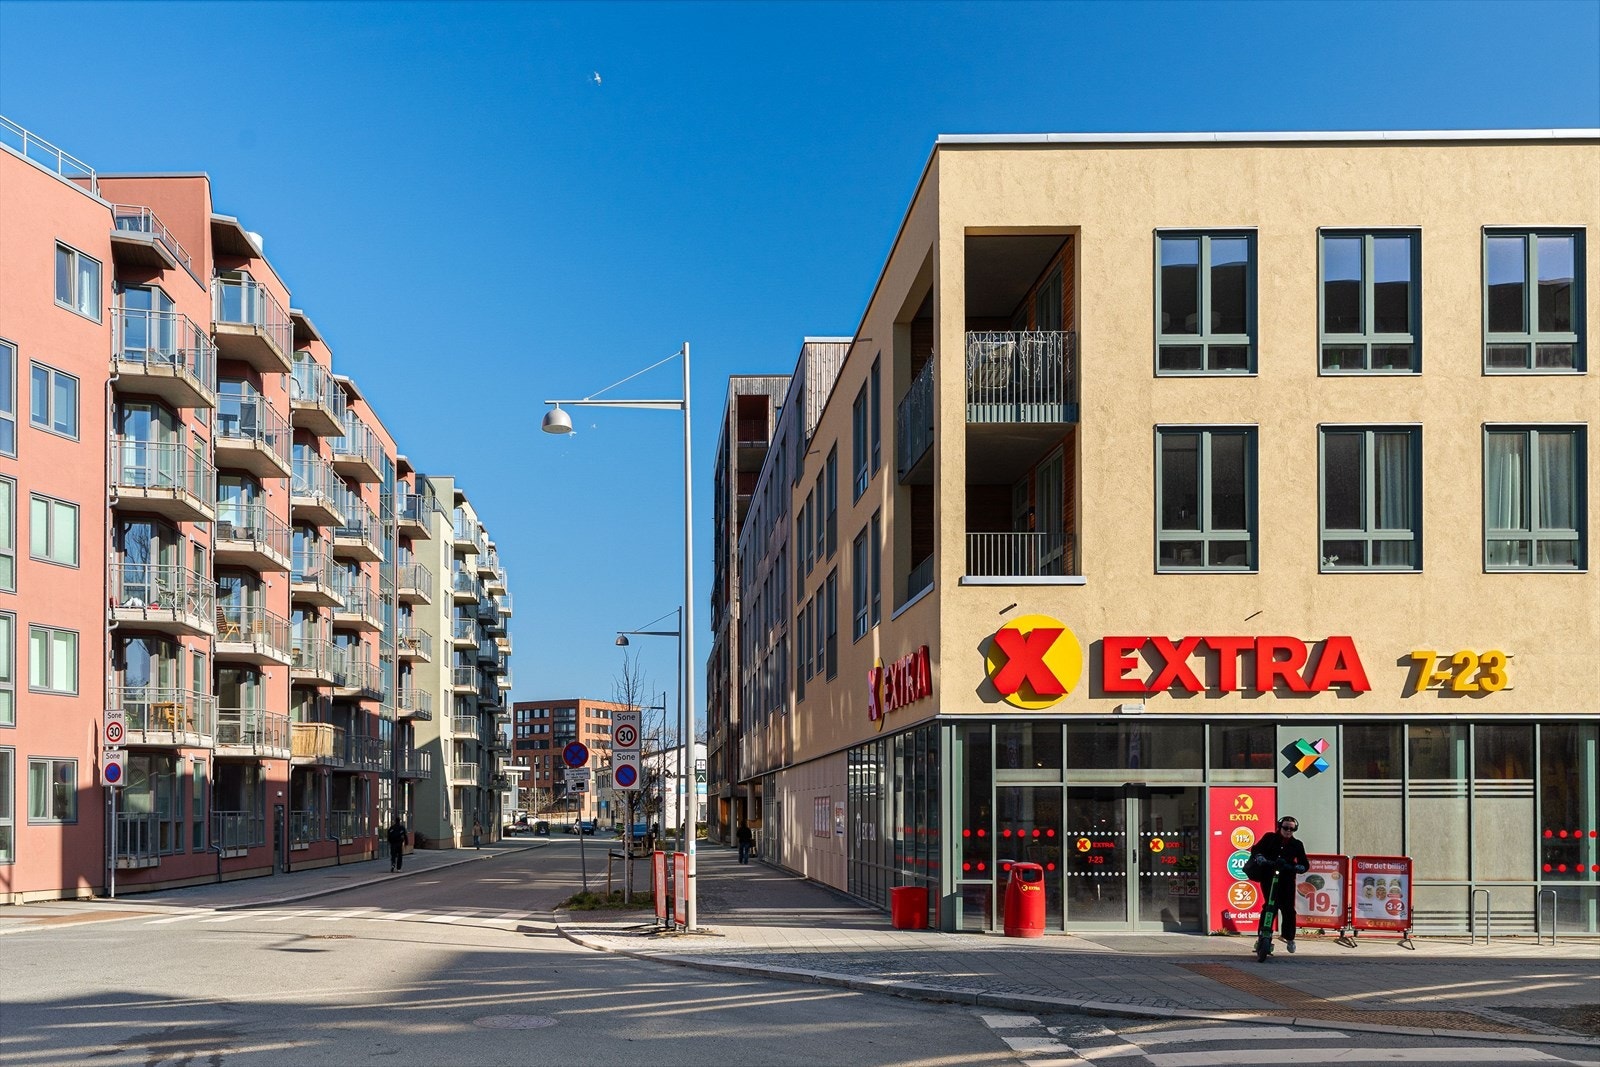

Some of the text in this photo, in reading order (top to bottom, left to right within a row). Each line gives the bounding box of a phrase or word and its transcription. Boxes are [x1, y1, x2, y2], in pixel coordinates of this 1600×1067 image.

[1103, 636, 1372, 692] EXTRA
[1411, 650, 1508, 692] 7-23
[883, 645, 933, 714] EXTRA
[616, 713, 636, 721] Sone
[109, 727, 120, 737] 30
[619, 730, 634, 742] 30
[1229, 813, 1259, 821] EXTRA
[1088, 856, 1104, 864] 7-23
[1161, 856, 1177, 864] 7-23
[1358, 861, 1372, 870] Gjør
[1373, 862, 1386, 870] det
[1387, 862, 1408, 871] billig!
[1234, 888, 1251, 901] 3%
